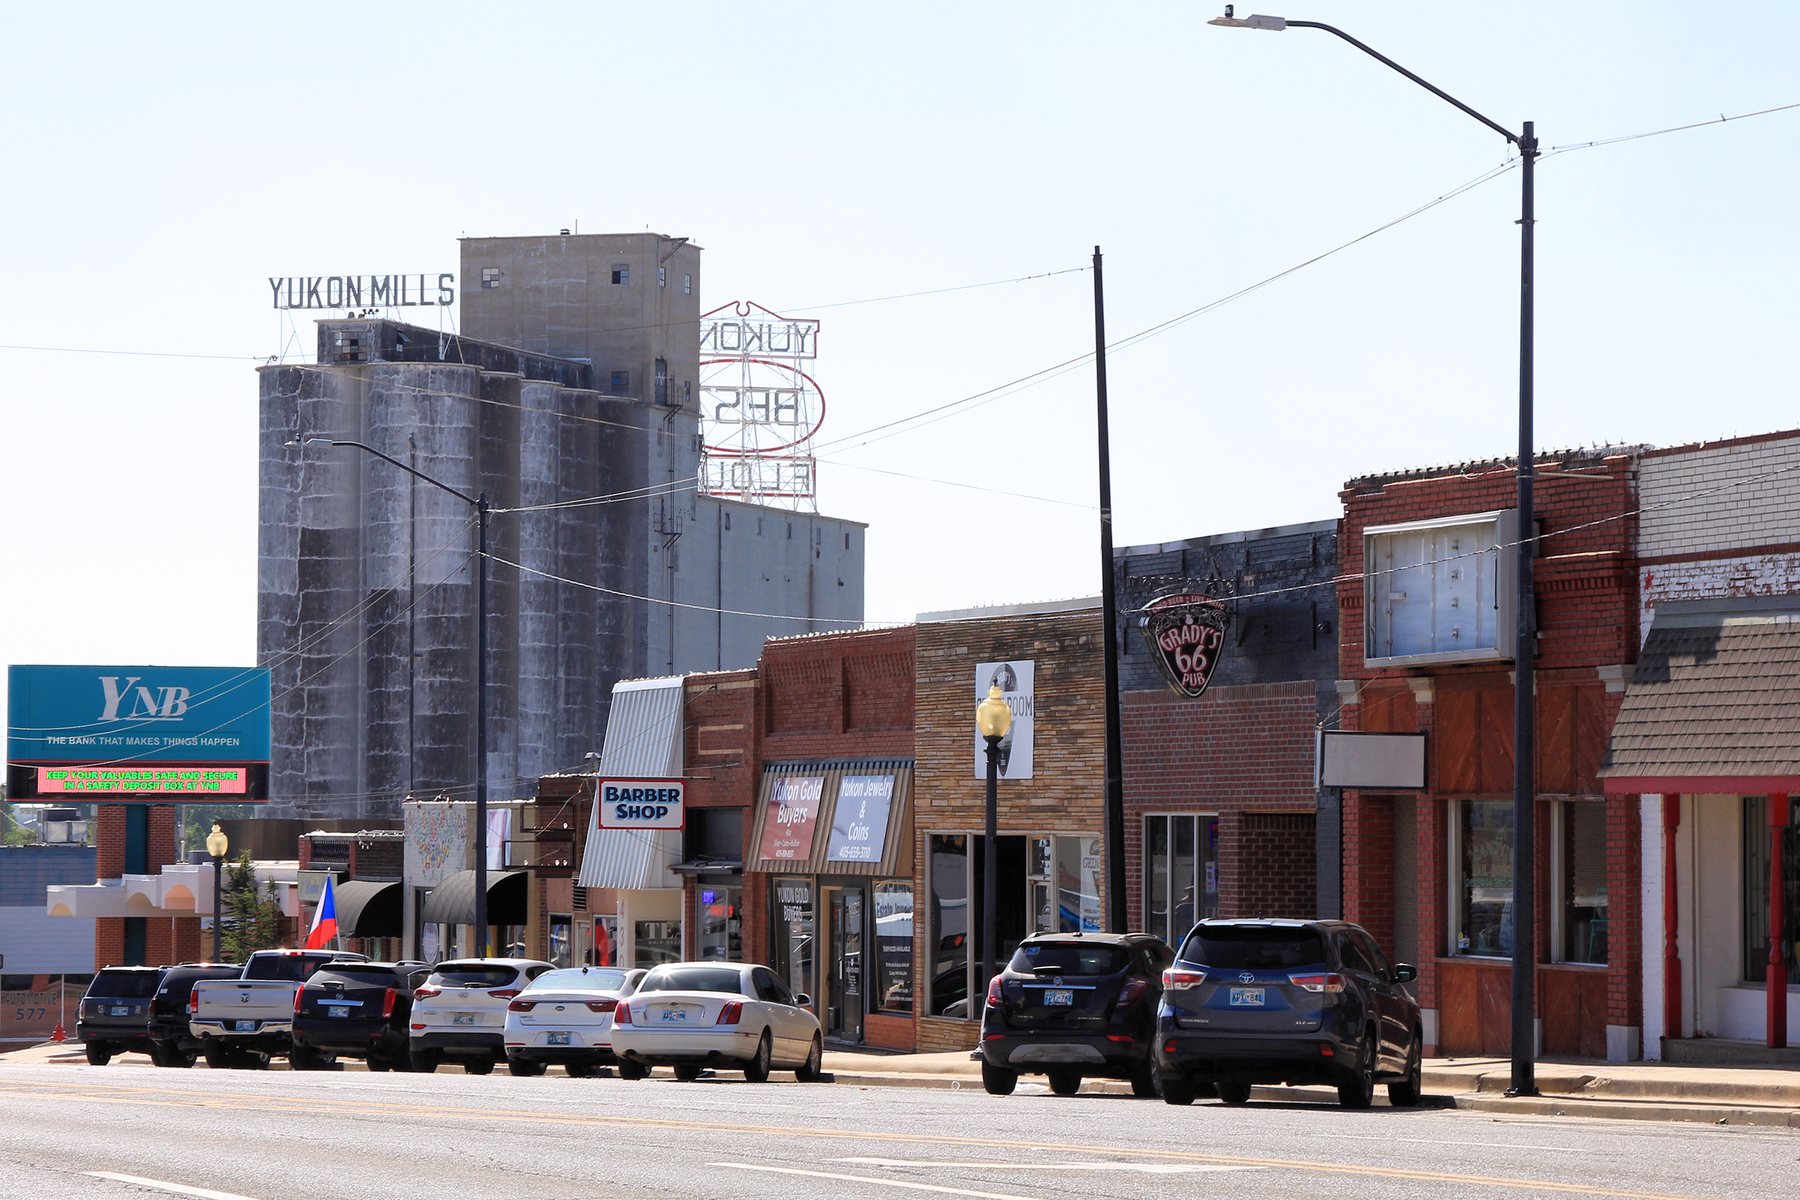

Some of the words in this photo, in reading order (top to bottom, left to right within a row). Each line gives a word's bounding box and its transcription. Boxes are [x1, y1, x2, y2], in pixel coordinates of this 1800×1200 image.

[269, 275, 362, 309] YUKON
[371, 273, 455, 307] MILLS
[1160, 624, 1221, 651] GRADY'S
[1175, 644, 1207, 673] 66
[1182, 672, 1206, 687] PUB
[97, 676, 190, 721] YNB
[47, 736, 66, 745] THE
[69, 736, 97, 745] BANK
[99, 737, 124, 745] THAT
[126, 737, 160, 746] MAKES
[163, 737, 198, 746] THINGS
[200, 738, 240, 746] HAPPEN
[47, 771, 68, 780] KEEP
[71, 771, 99, 780] YOUR
[101, 771, 153, 780] VALUABLES
[155, 771, 178, 780] SAFE
[179, 771, 200, 780] AND
[203, 771, 238, 780] SECURE
[63, 781, 75, 790] IN
[77, 781, 84, 790] A
[86, 781, 120, 790] SAFETY
[122, 781, 160, 790] DEPOSIT
[164, 781, 184, 790] BOX
[186, 781, 198, 790] AT
[200, 781, 220, 790] YNB
[771, 781, 799, 801] Yukon
[801, 779, 823, 801] Gold
[840, 779, 863, 798] Yukon
[864, 777, 894, 800] Jewelry
[604, 786, 681, 804] BARBER
[615, 803, 669, 819] SHOP
[776, 804, 808, 827] Buyers
[858, 800, 866, 819] &
[847, 822, 870, 841] Coins
[776, 887, 795, 904] YUKON
[795, 887, 809, 904] GOLD
[783, 905, 803, 922] BUYERS
[5, 992, 57, 1006] AUTOMOTIVE
[16, 1008, 46, 1021] 577
